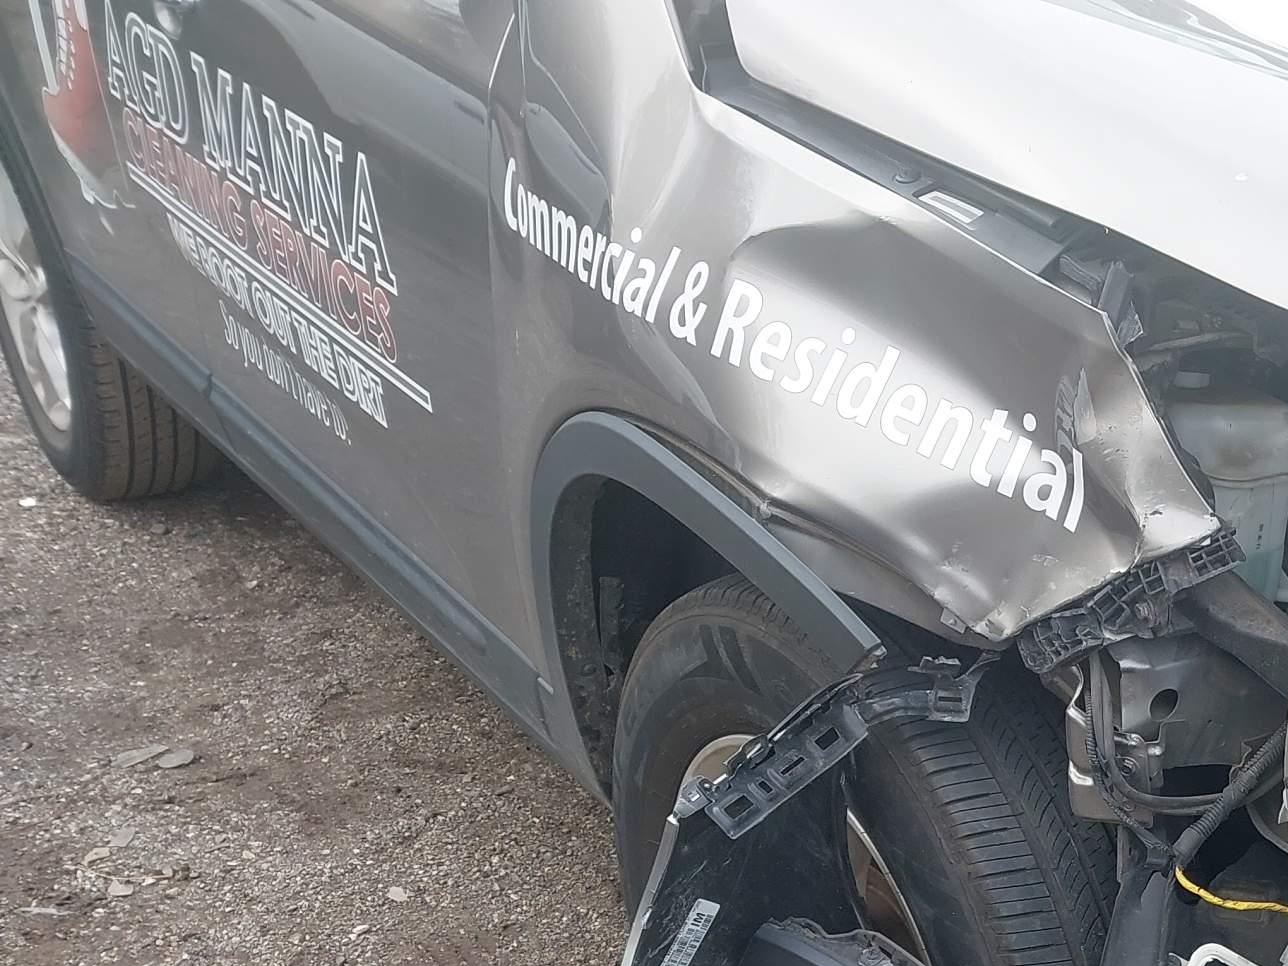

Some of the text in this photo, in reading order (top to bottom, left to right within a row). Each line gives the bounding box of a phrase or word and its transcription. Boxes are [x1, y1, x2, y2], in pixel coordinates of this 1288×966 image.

[104, 0, 398, 297] AGD MANNA
[122, 107, 397, 363] CLEANING SERVICES
[166, 212, 389, 429] WE ROOT OUT THE DIRT
[219, 299, 239, 350] So
[237, 321, 263, 371] you
[503, 156, 1085, 534] Commercial & Residential
